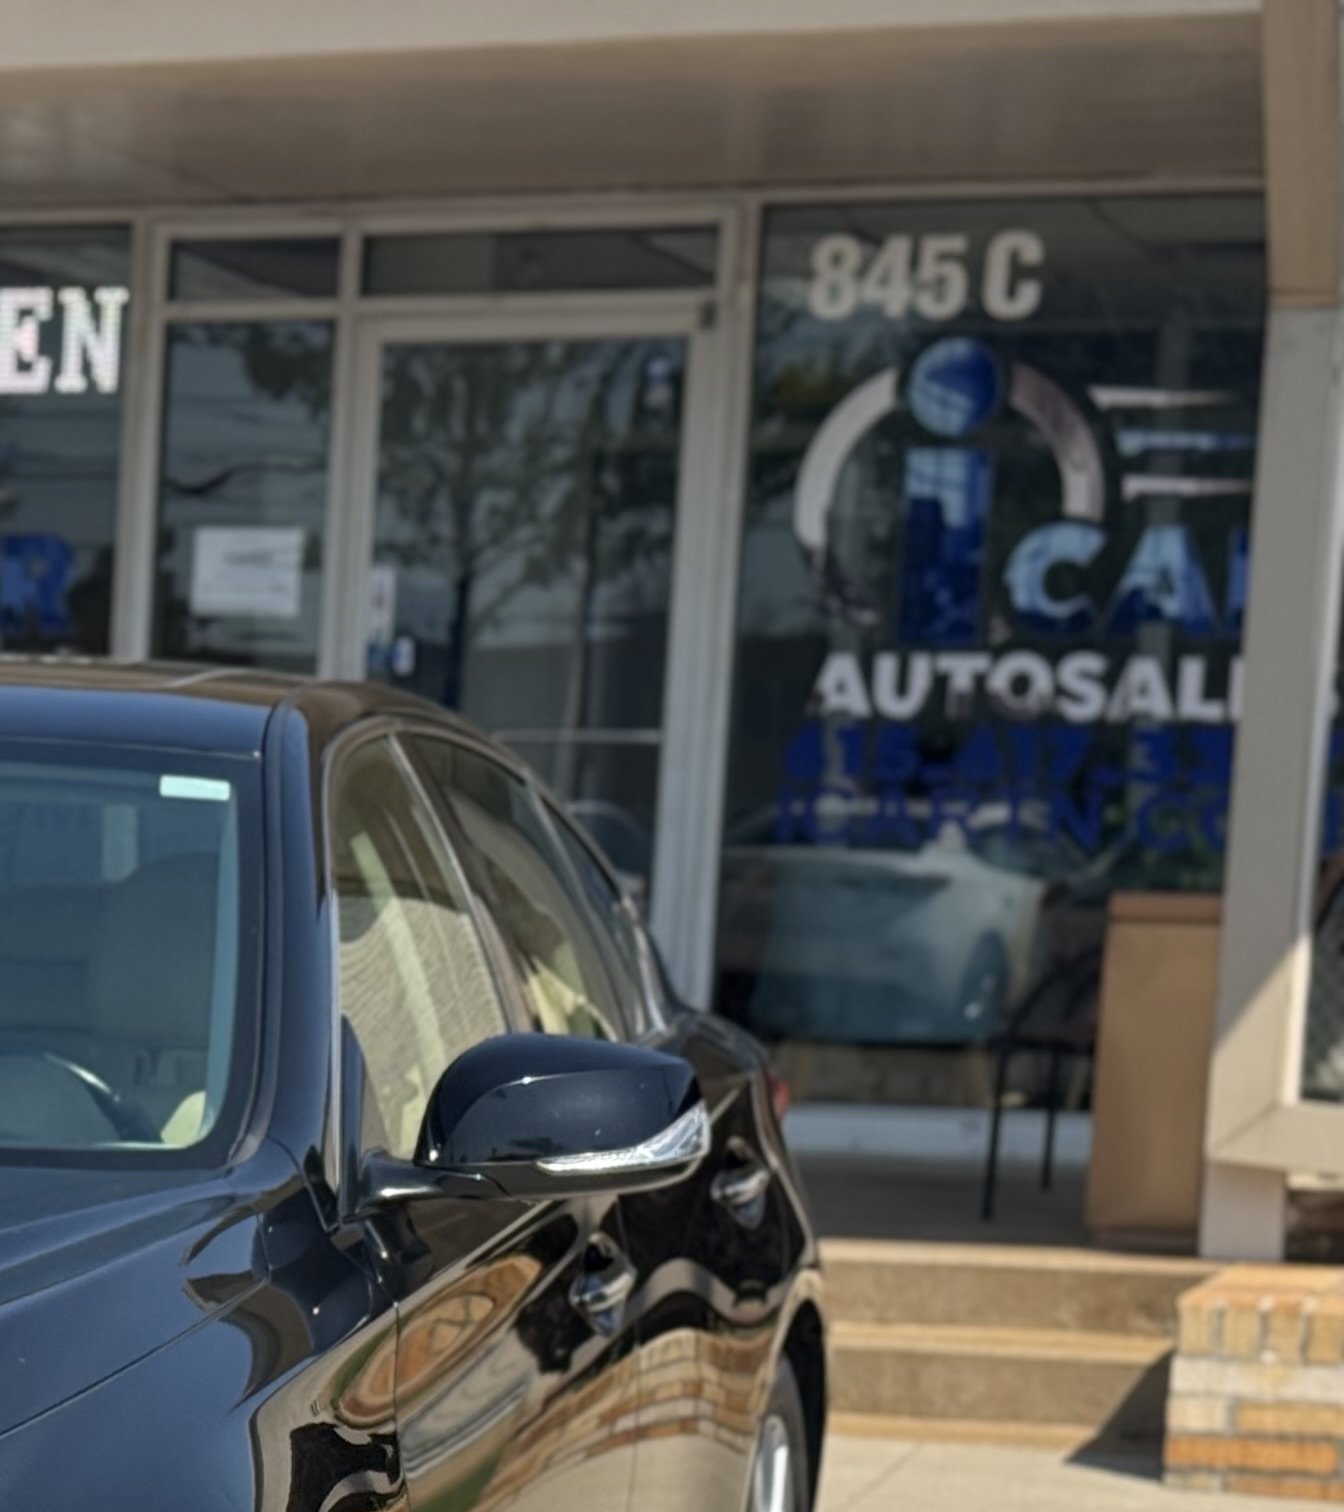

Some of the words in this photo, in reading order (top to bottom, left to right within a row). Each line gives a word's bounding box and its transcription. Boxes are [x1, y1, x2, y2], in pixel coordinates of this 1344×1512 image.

[810, 232, 970, 320] 845
[982, 229, 1044, 321] C
[809, 649, 1246, 723] AUTOSAL
[780, 721, 1234, 784] 615-617-33
